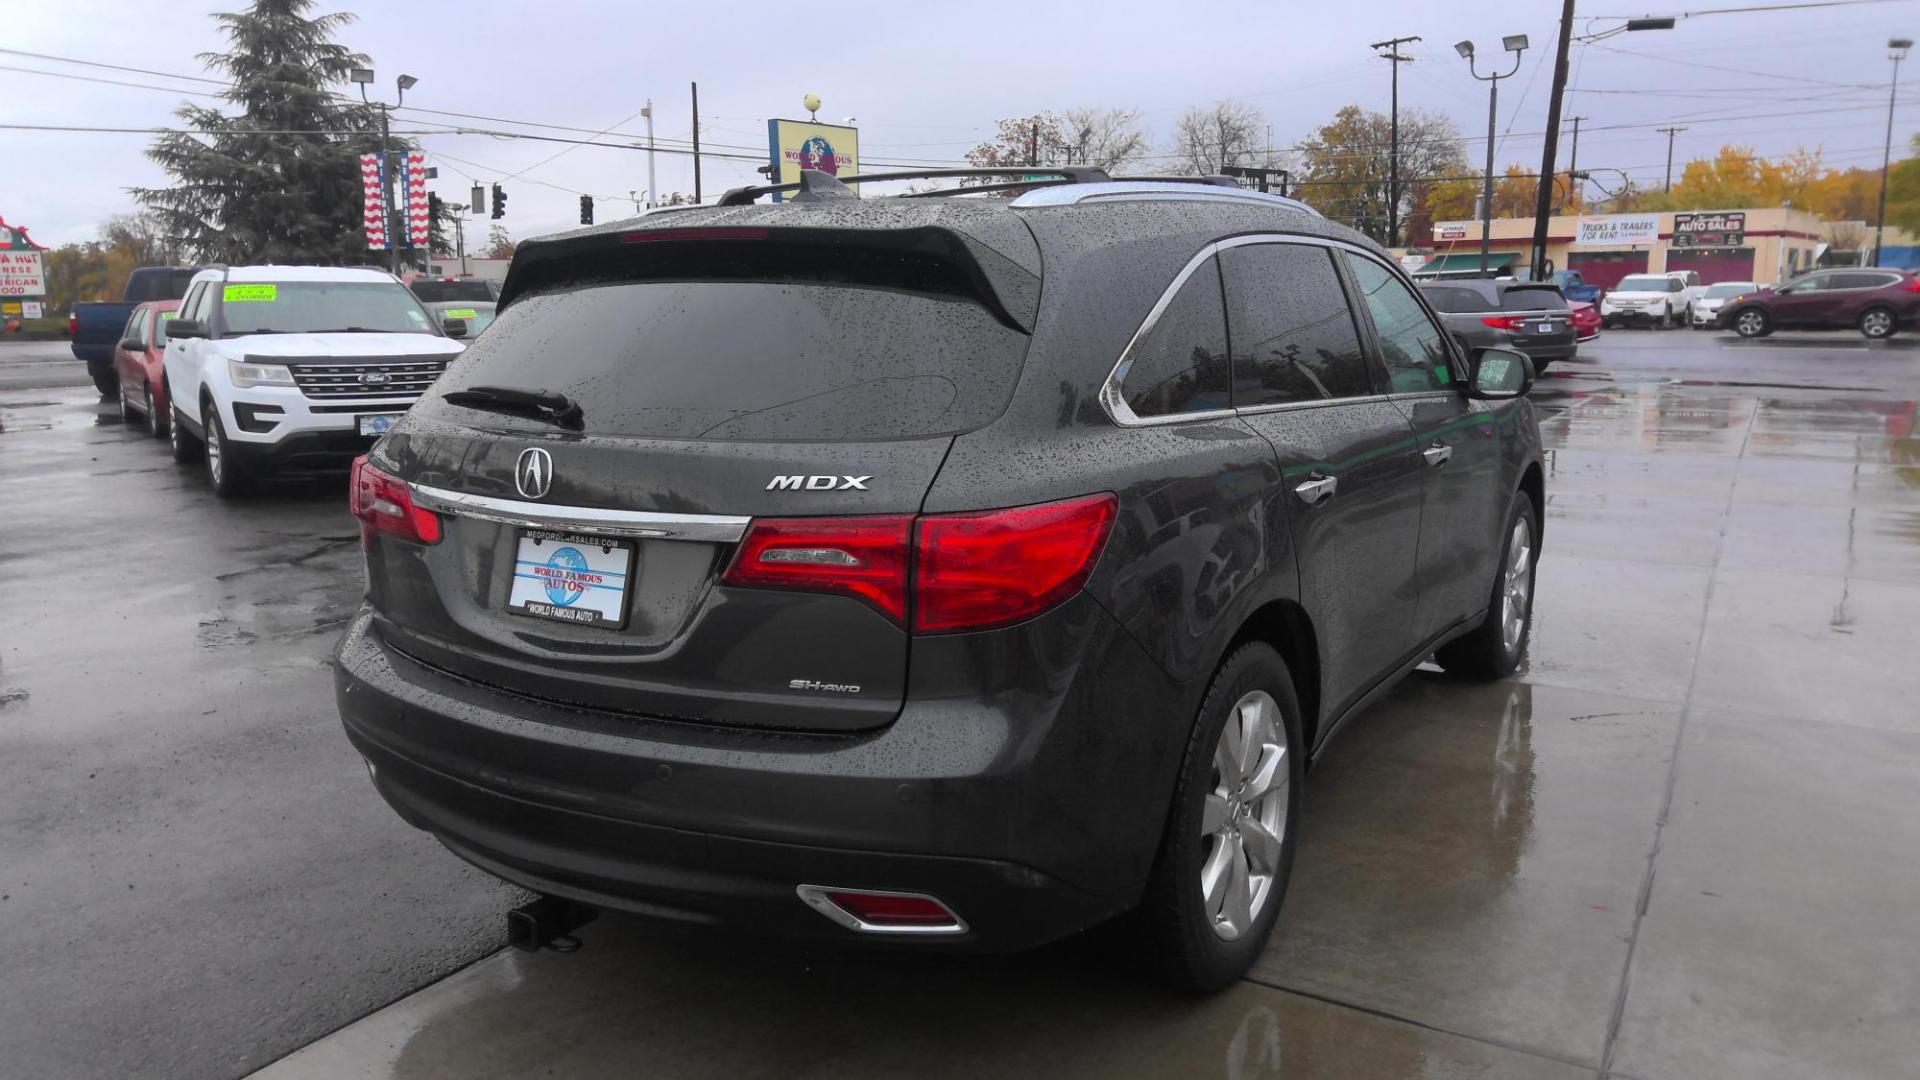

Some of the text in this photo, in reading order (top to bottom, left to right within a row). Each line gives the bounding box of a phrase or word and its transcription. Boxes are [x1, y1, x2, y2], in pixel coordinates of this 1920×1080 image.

[1582, 223, 1608, 232] TRUCKS
[1620, 222, 1654, 231] TRAILERS
[1678, 221, 1740, 232] AUTO SALES
[1582, 232, 1597, 240] FOR
[1599, 231, 1618, 240] RENT
[765, 475, 876, 491] MDX
[534, 567, 603, 584] WORLD FAMOUS
[545, 579, 585, 592] AUTOS
[529, 604, 593, 622] WORLD FAMOUS AUTO
[788, 679, 860, 693] SH-AWD
